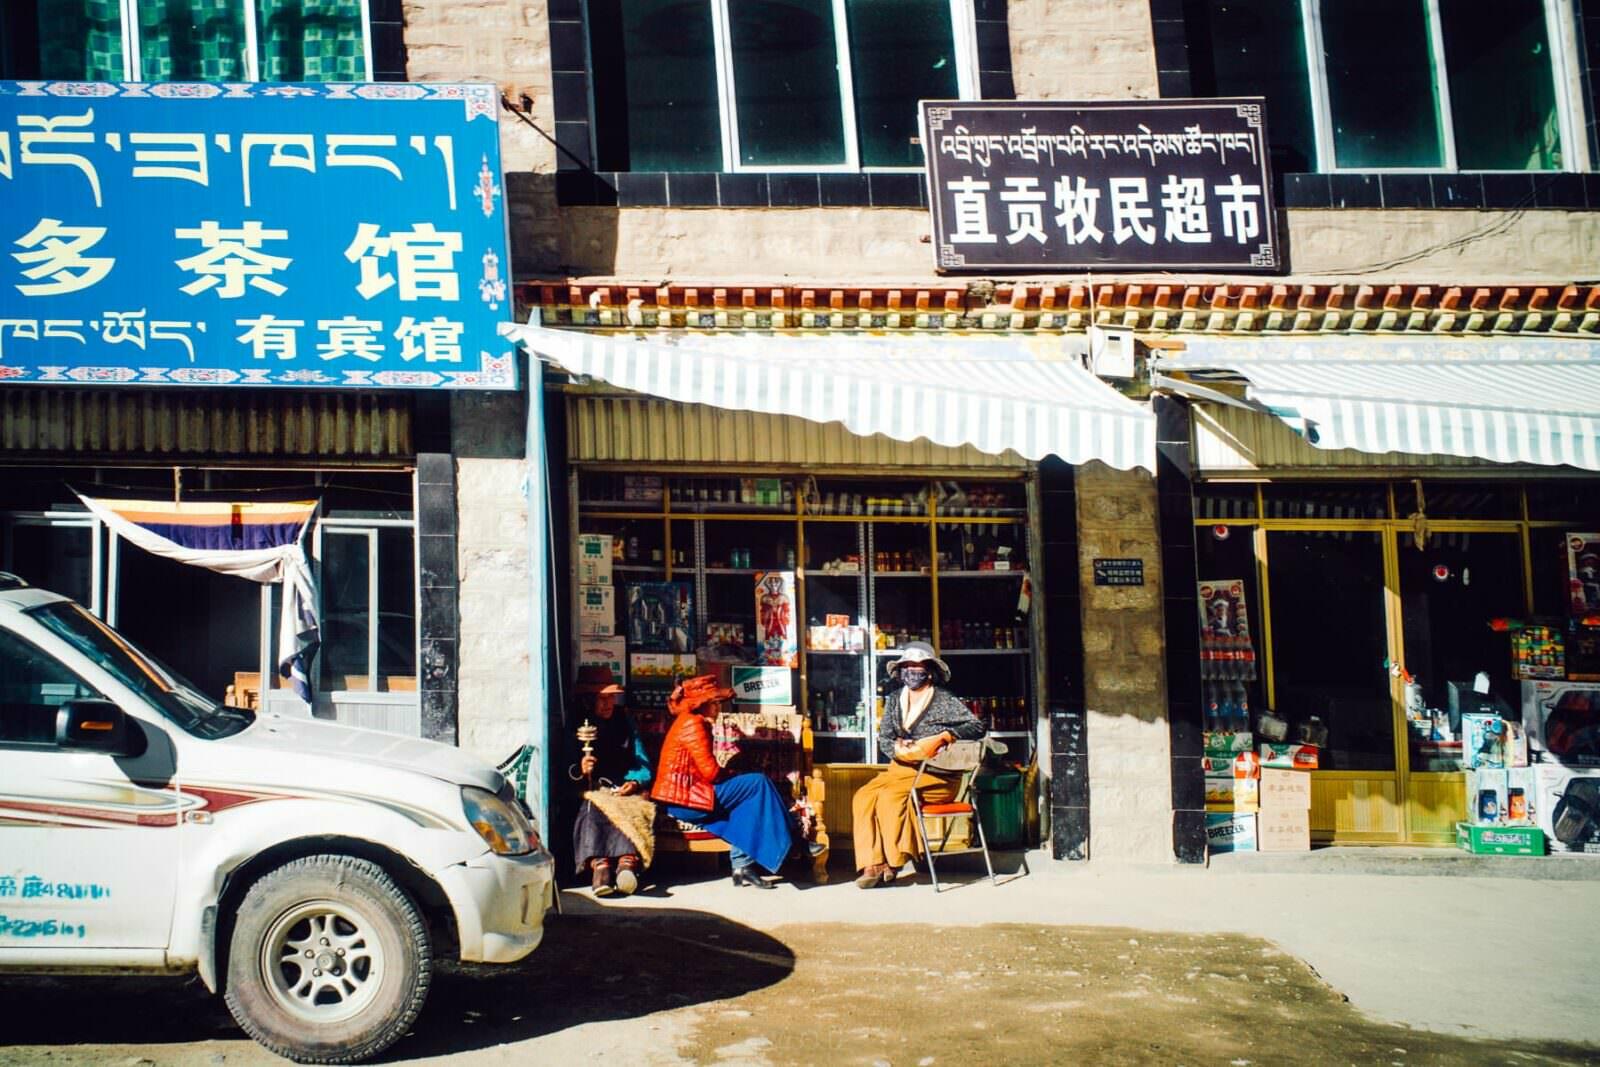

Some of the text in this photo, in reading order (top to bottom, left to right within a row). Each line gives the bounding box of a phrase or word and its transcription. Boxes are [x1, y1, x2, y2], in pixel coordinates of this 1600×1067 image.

[0, 107, 457, 210] དོ་ཇ་ཁང་།
[946, 174, 1262, 245] 直贡牧民超市
[11, 218, 464, 302] 多茶馆
[235, 313, 465, 363] 有宾馆
[1207, 824, 1245, 839] BREEZER
